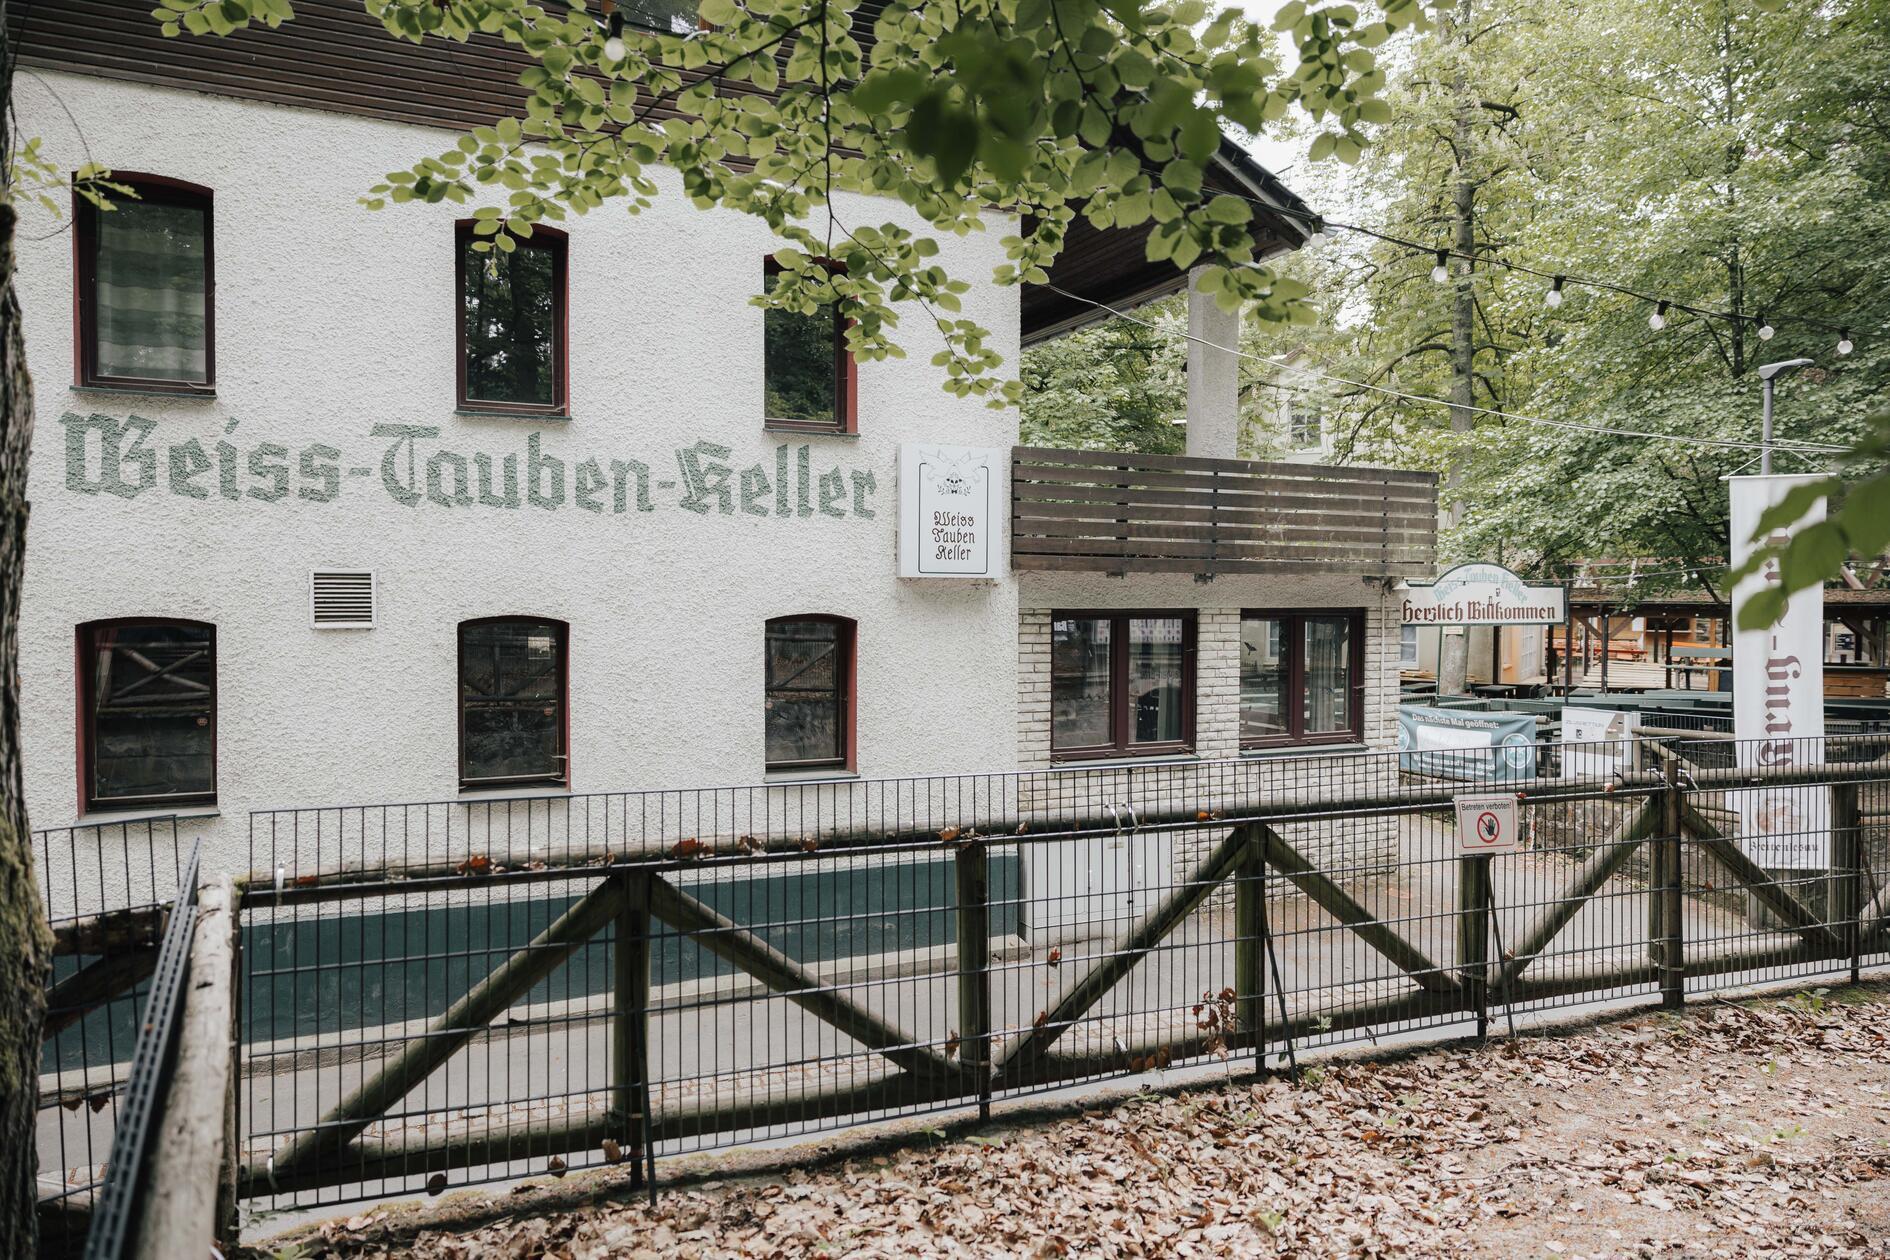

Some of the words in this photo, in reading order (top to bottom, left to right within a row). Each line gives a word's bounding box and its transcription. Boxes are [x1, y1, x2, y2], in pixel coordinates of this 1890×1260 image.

[933, 511, 975, 527] Weiss
[931, 528, 976, 543] Tauben
[935, 545, 972, 560] Keller
[1402, 598, 1464, 623] Herzlich
[1467, 600, 1556, 621] Willkommen
[1412, 713, 1425, 722] Das
[1424, 715, 1451, 725] nächste
[1451, 718, 1465, 727] Mal
[1465, 719, 1500, 729] geöffnet:
[1461, 803, 1485, 811] Betreten
[1486, 801, 1512, 810] verboten!
